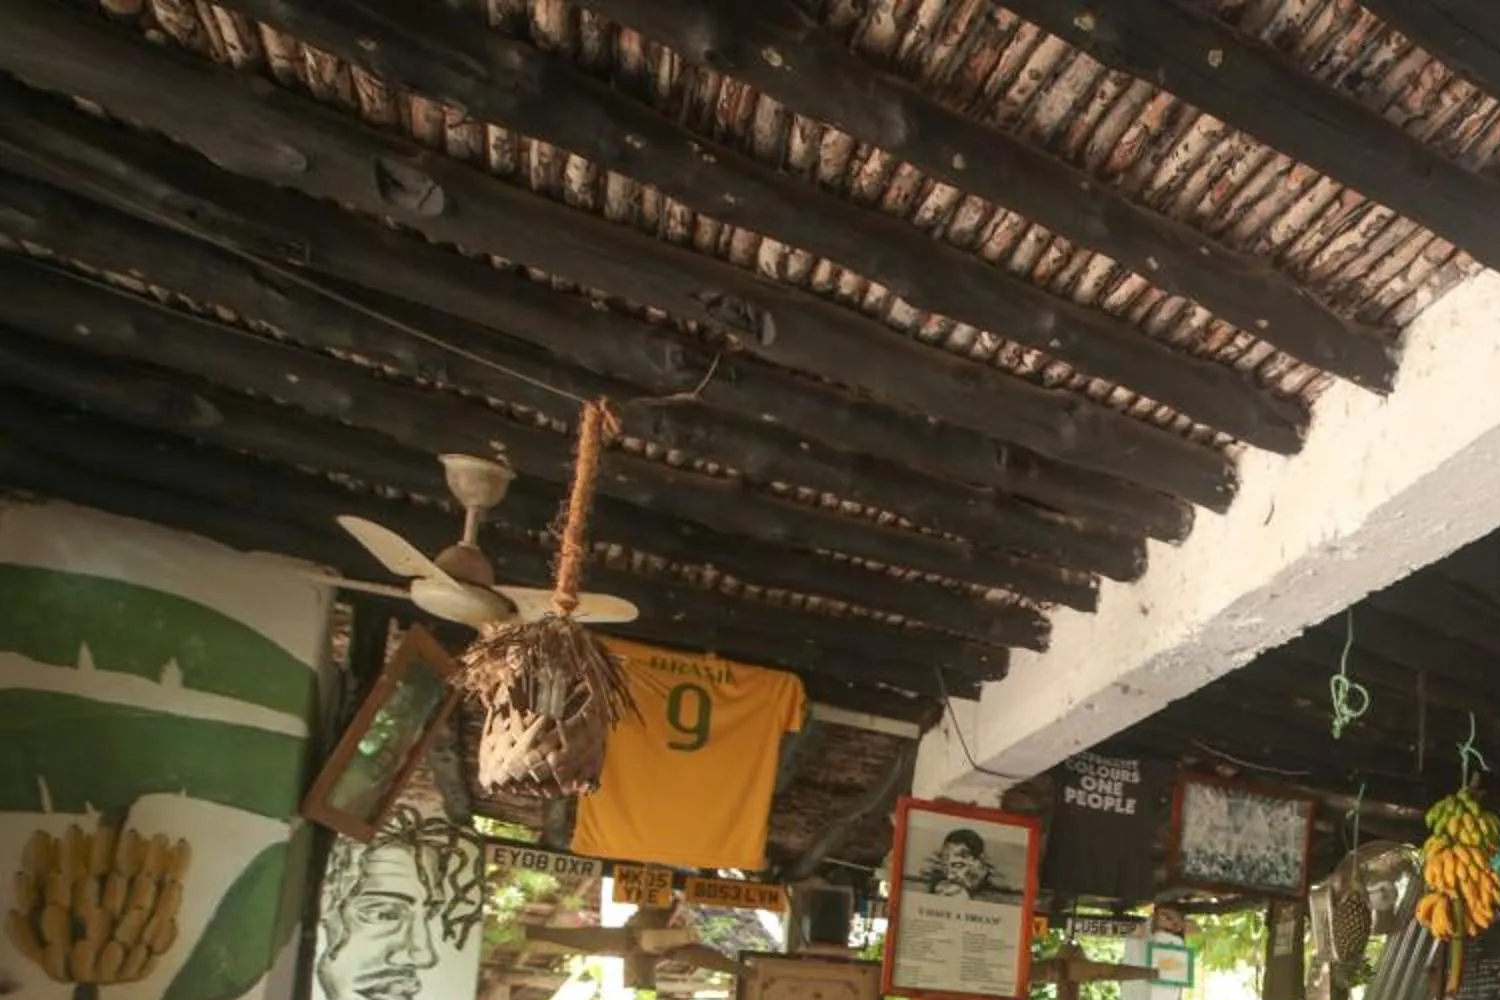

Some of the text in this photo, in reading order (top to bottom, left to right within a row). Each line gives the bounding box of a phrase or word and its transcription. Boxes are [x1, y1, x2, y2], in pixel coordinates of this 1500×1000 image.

[667, 682, 712, 752] 9
[1064, 785, 1137, 815] PEOPLE
[1081, 775, 1123, 797] ONE
